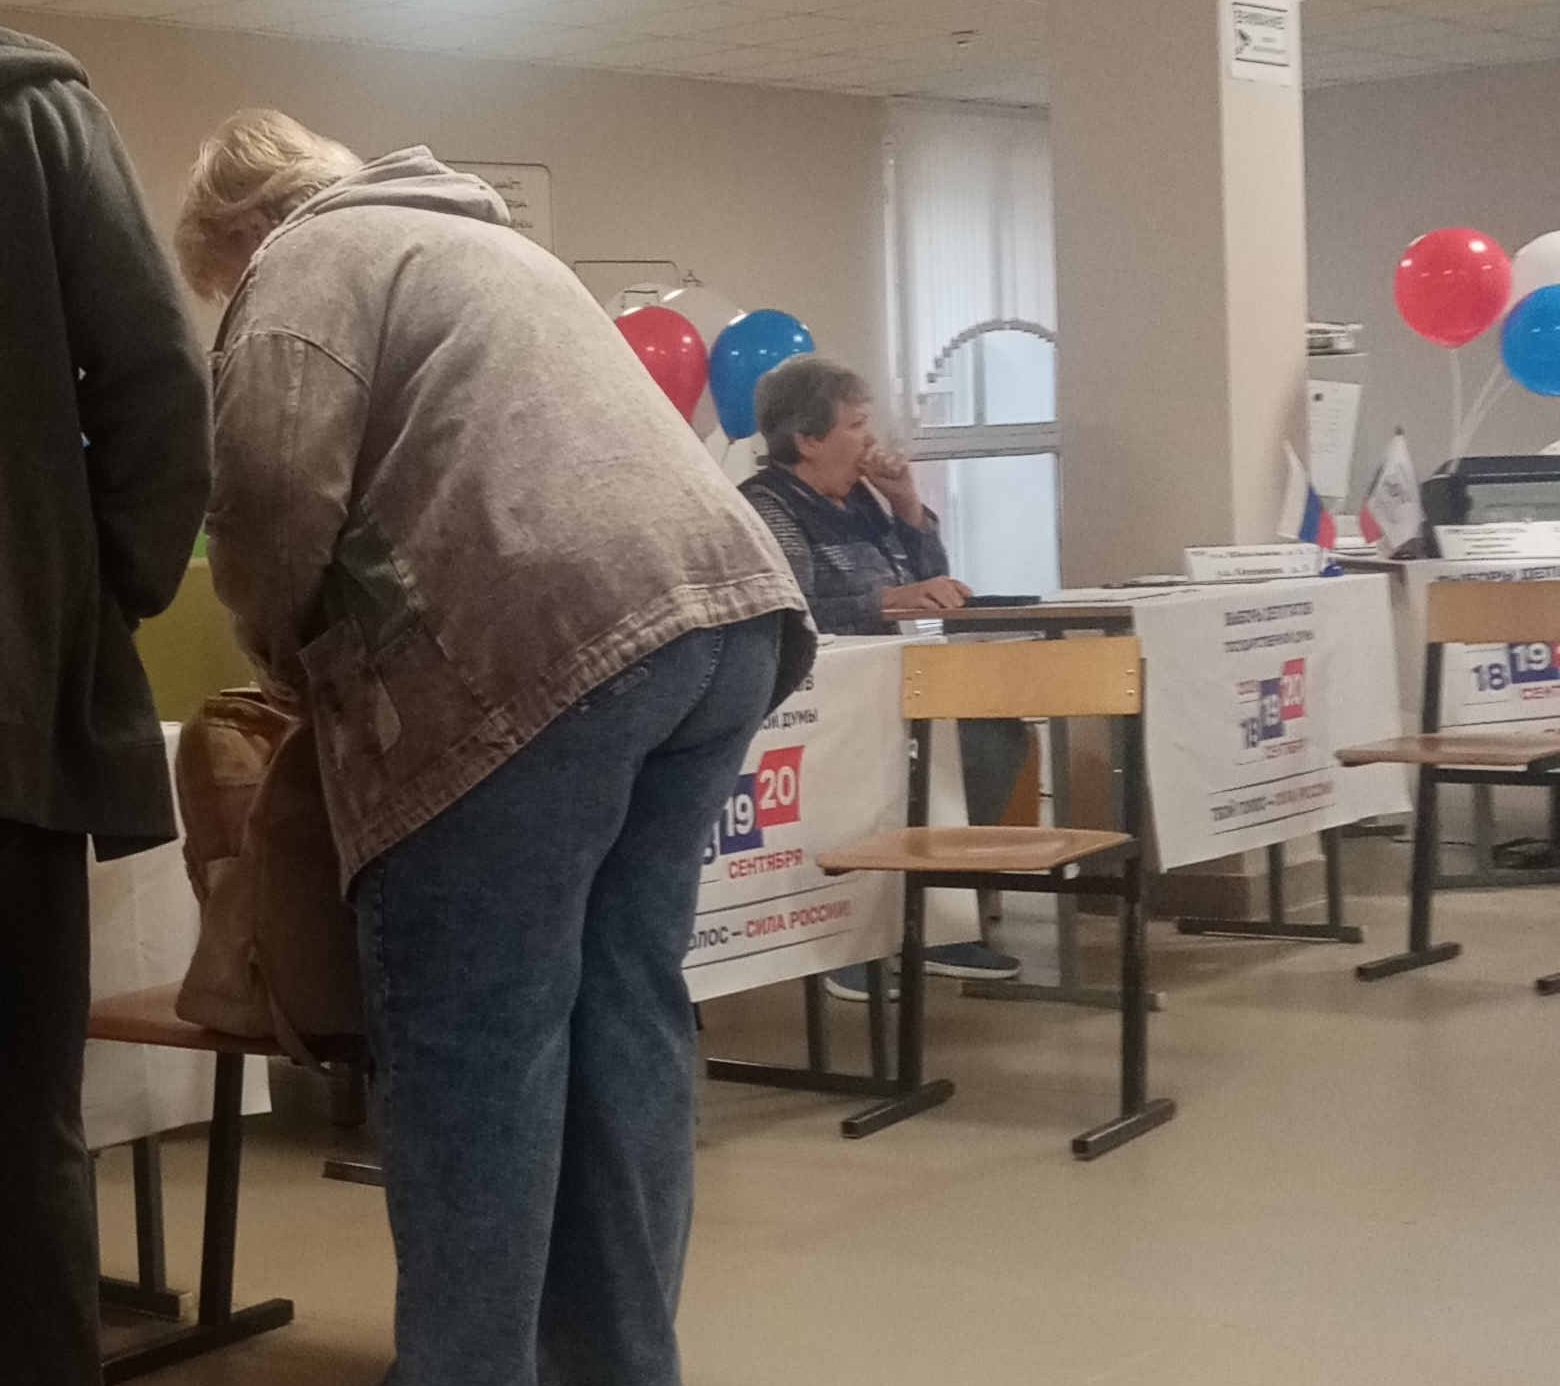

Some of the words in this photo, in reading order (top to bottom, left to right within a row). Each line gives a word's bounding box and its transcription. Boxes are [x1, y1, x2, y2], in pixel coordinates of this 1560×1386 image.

[1511, 642, 1552, 672] 19
[1473, 663, 1510, 691] 18
[782, 709, 818, 731] ДУМЫ
[759, 765, 797, 809] 20
[723, 793, 755, 838] 19
[727, 848, 804, 880] СЕНТЯБРЯ
[745, 911, 787, 939] СИЛА
